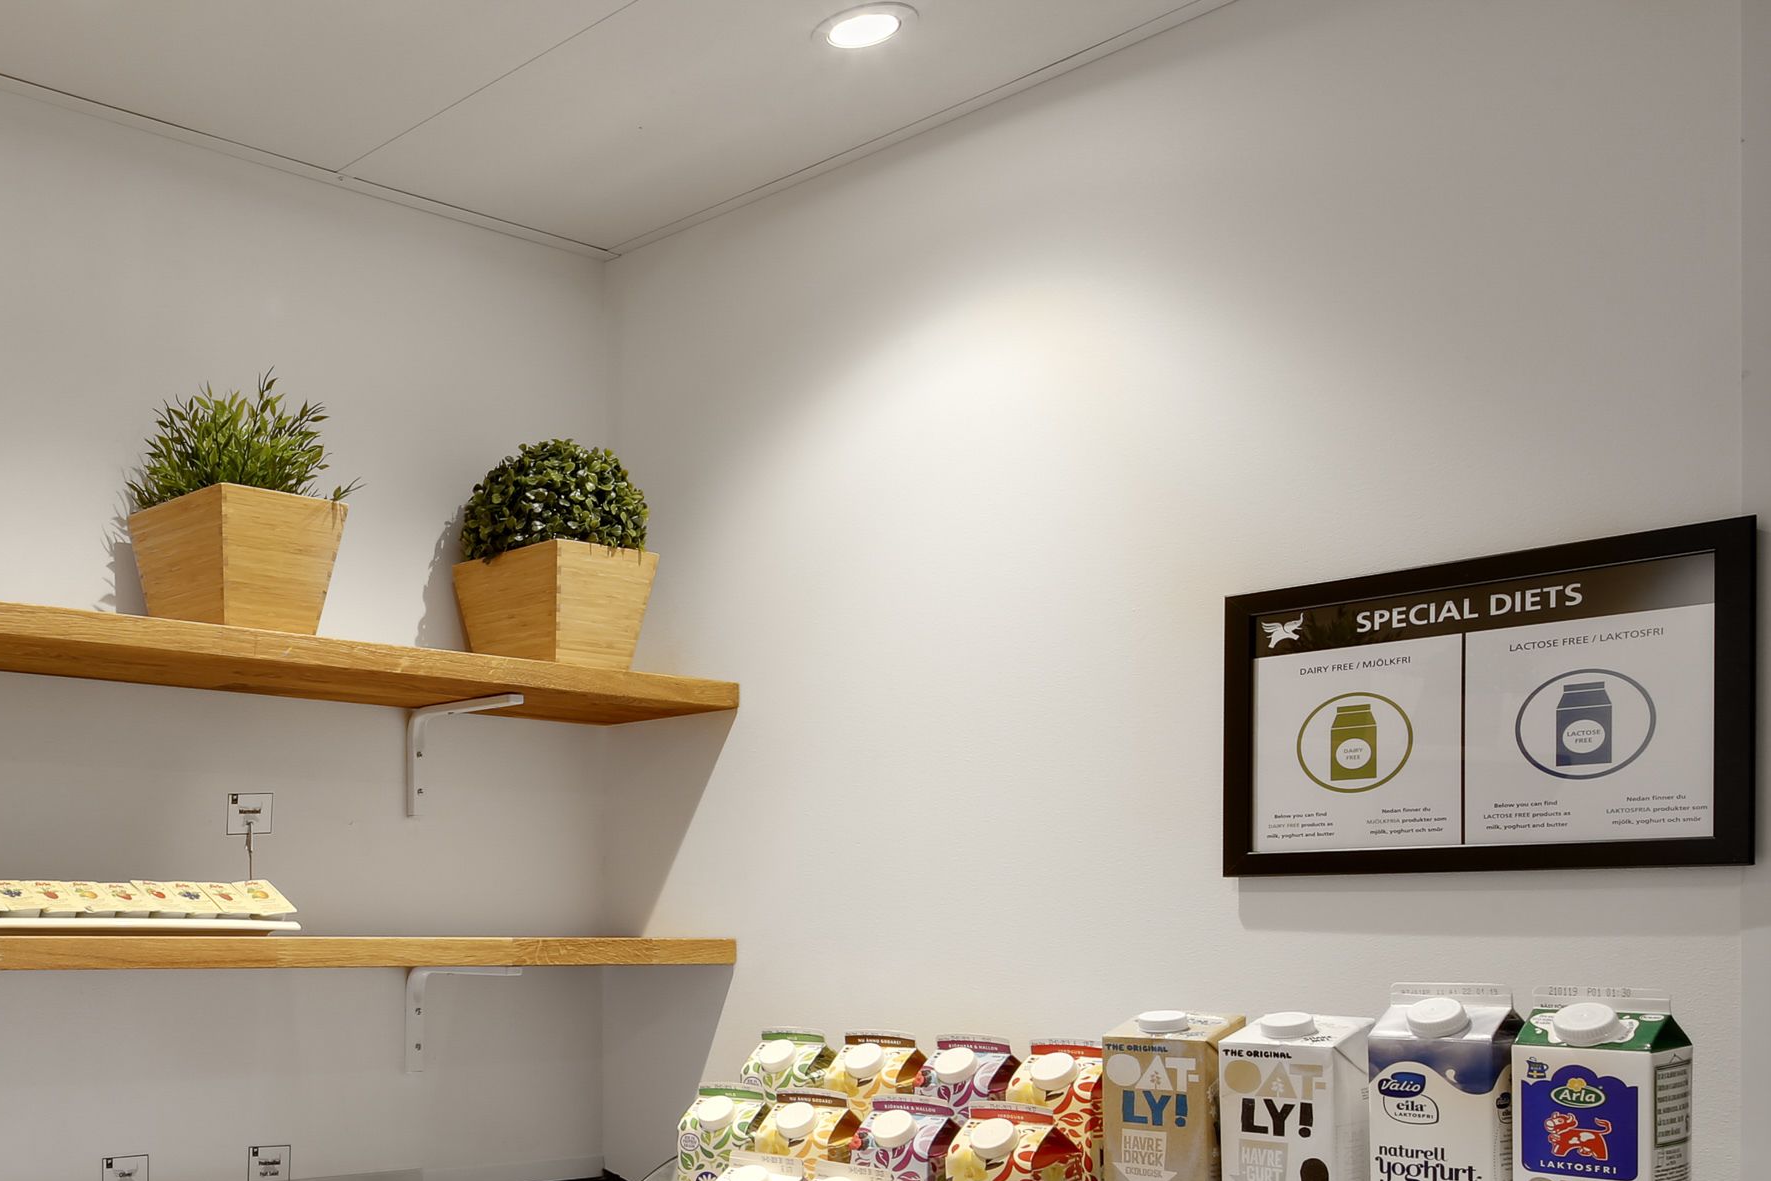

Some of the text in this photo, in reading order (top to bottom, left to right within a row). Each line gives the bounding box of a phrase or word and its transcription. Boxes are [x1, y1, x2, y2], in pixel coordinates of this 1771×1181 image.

[1356, 583, 1583, 633] SPECIAL DIETS
[1509, 639, 1559, 652] LACTOSE
[1562, 635, 1589, 646] FREE
[1599, 627, 1664, 642] LAKTOSFRI
[1299, 666, 1329, 675] DAIRY
[1331, 662, 1353, 672] FREE
[1362, 656, 1411, 669] MJÖLKFRI
[1566, 729, 1602, 737] LACTOSE
[1626, 795, 1651, 803] Nedan
[1483, 812, 1513, 820] LACTOSE
[1532, 811, 1562, 819] products
[1606, 806, 1651, 815] LAKTOSFRIA
[1652, 805, 1691, 814] produkter
[1503, 823, 1531, 831] yoghurt
[1548, 986, 1578, 996] 210119
[1587, 987, 1601, 997] P01
[1105, 1043, 1168, 1053] THE ORIGINAL
[1223, 1049, 1292, 1059] THE ORIGINAL
[1380, 1079, 1421, 1092] Valio
[1558, 1090, 1596, 1103] Arla
[1122, 1090, 1188, 1127] LY!
[1396, 1100, 1425, 1112] eila
[1241, 1098, 1314, 1138] LY!
[1394, 1111, 1434, 1119] LAKTOSFRI
[1123, 1135, 1163, 1153] HAVRE
[1123, 1151, 1164, 1168] DRYCK
[1241, 1146, 1284, 1168] HAVRE
[1378, 1144, 1448, 1162] naturell
[1125, 1166, 1163, 1178] EKOLOGISK
[1540, 1159, 1617, 1174] LAKTOSFRI
